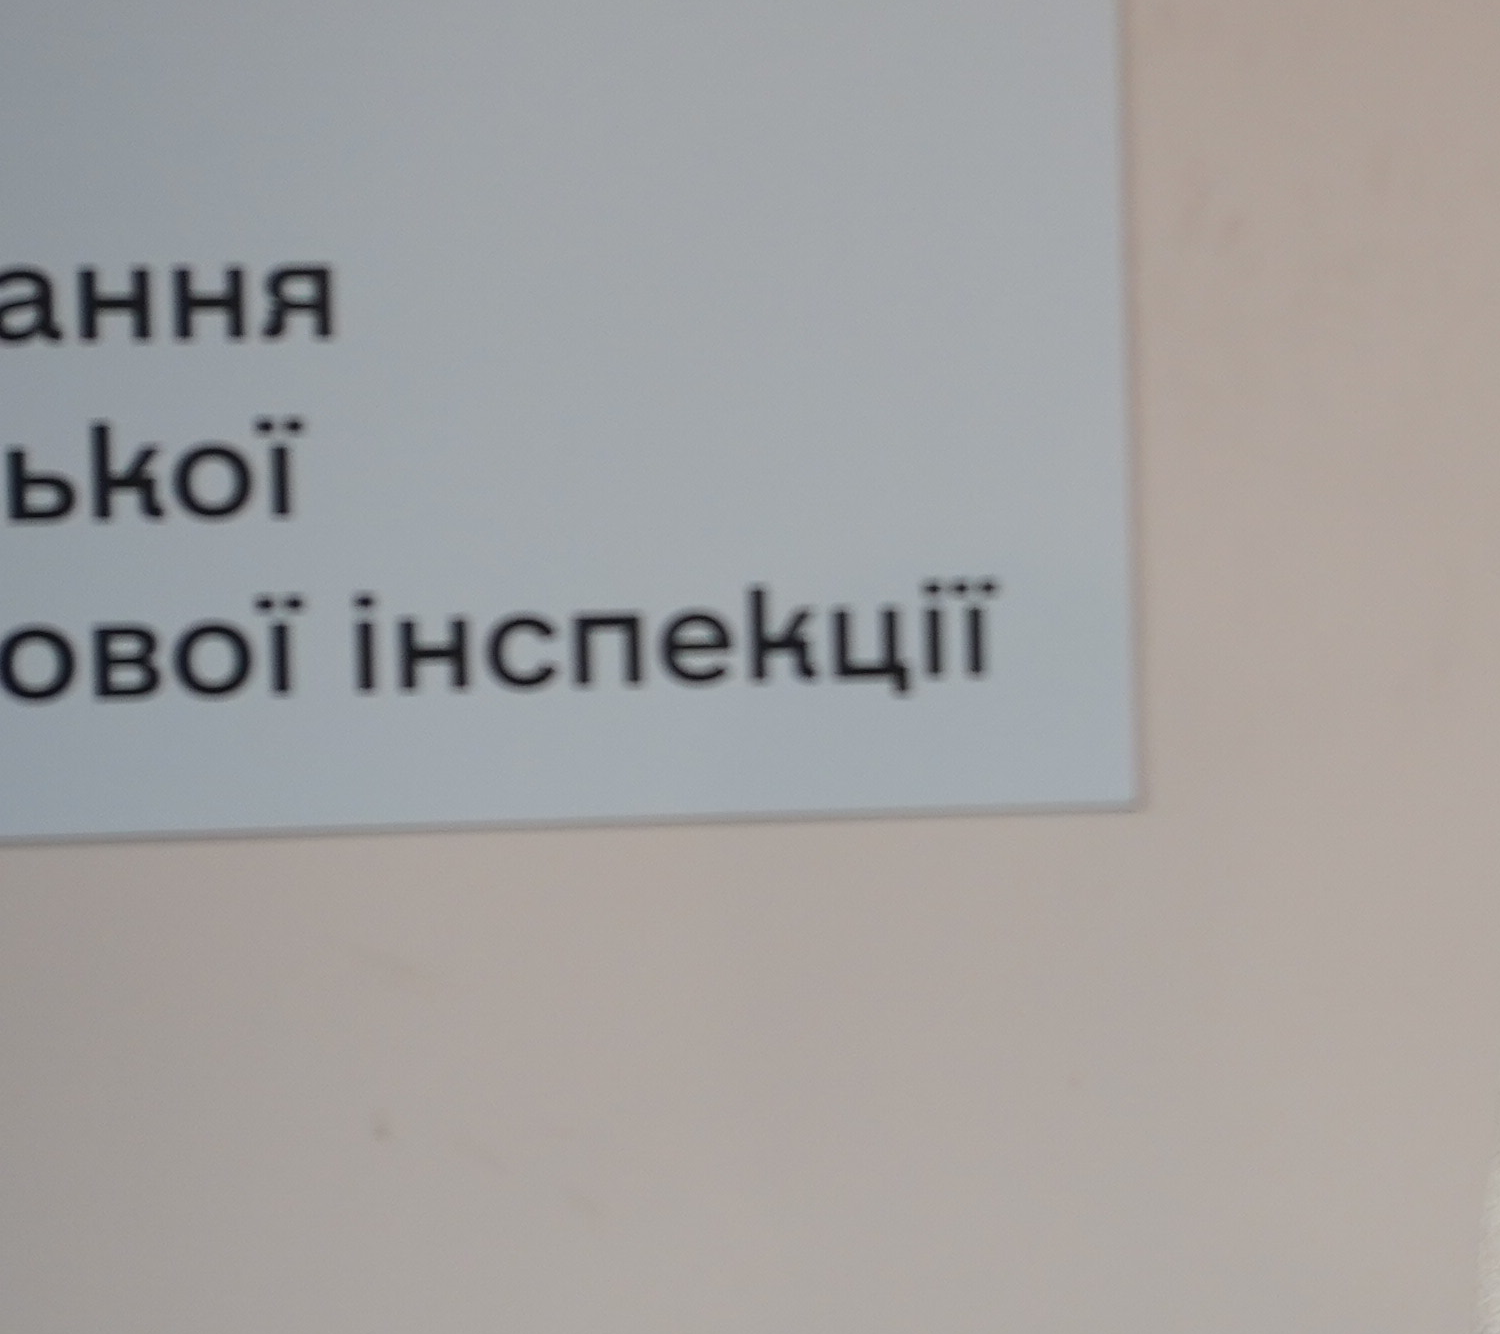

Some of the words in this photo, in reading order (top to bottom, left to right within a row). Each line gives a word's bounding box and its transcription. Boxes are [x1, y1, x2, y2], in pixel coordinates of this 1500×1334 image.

[0, 263, 335, 344] ання
[5, 417, 306, 524] ької
[0, 595, 306, 703] ової
[351, 577, 1000, 698] інспекції
